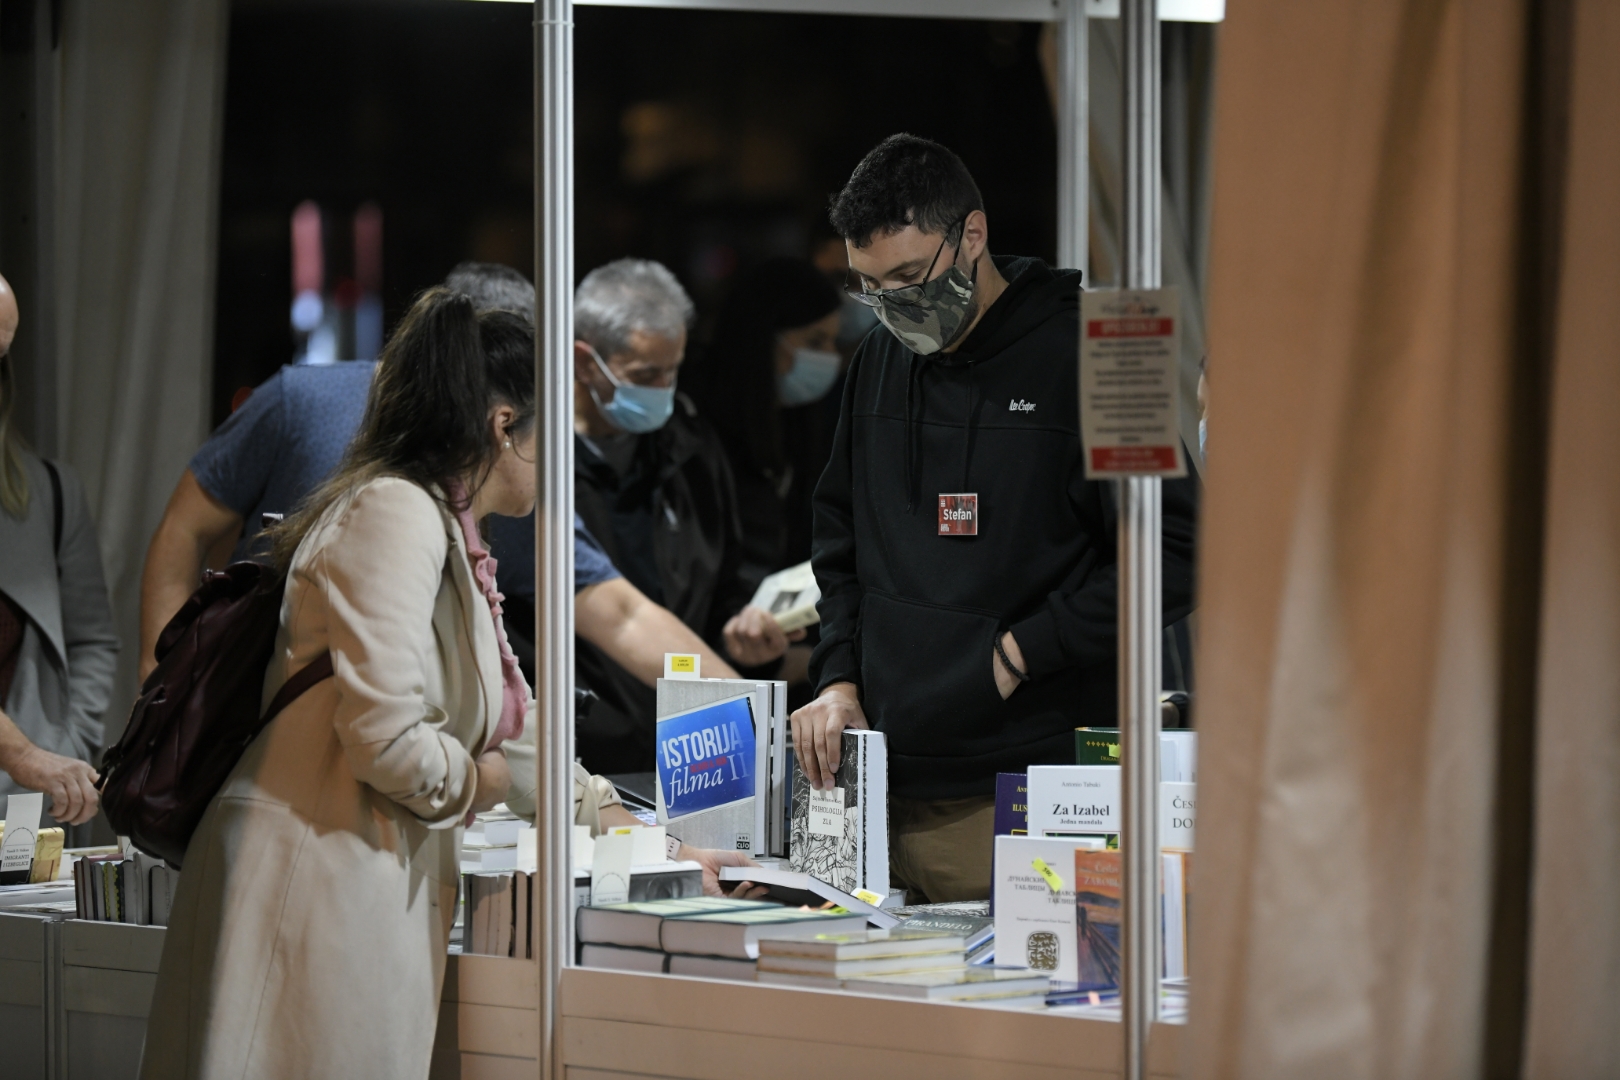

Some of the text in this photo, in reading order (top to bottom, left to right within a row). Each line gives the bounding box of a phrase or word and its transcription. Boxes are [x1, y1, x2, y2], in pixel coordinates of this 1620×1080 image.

[943, 508, 972, 520] Stefan
[661, 721, 744, 769] ISTORIJA
[667, 765, 724, 808] filma
[728, 752, 750, 780] II
[1052, 804, 1110, 816] Za Izabel
